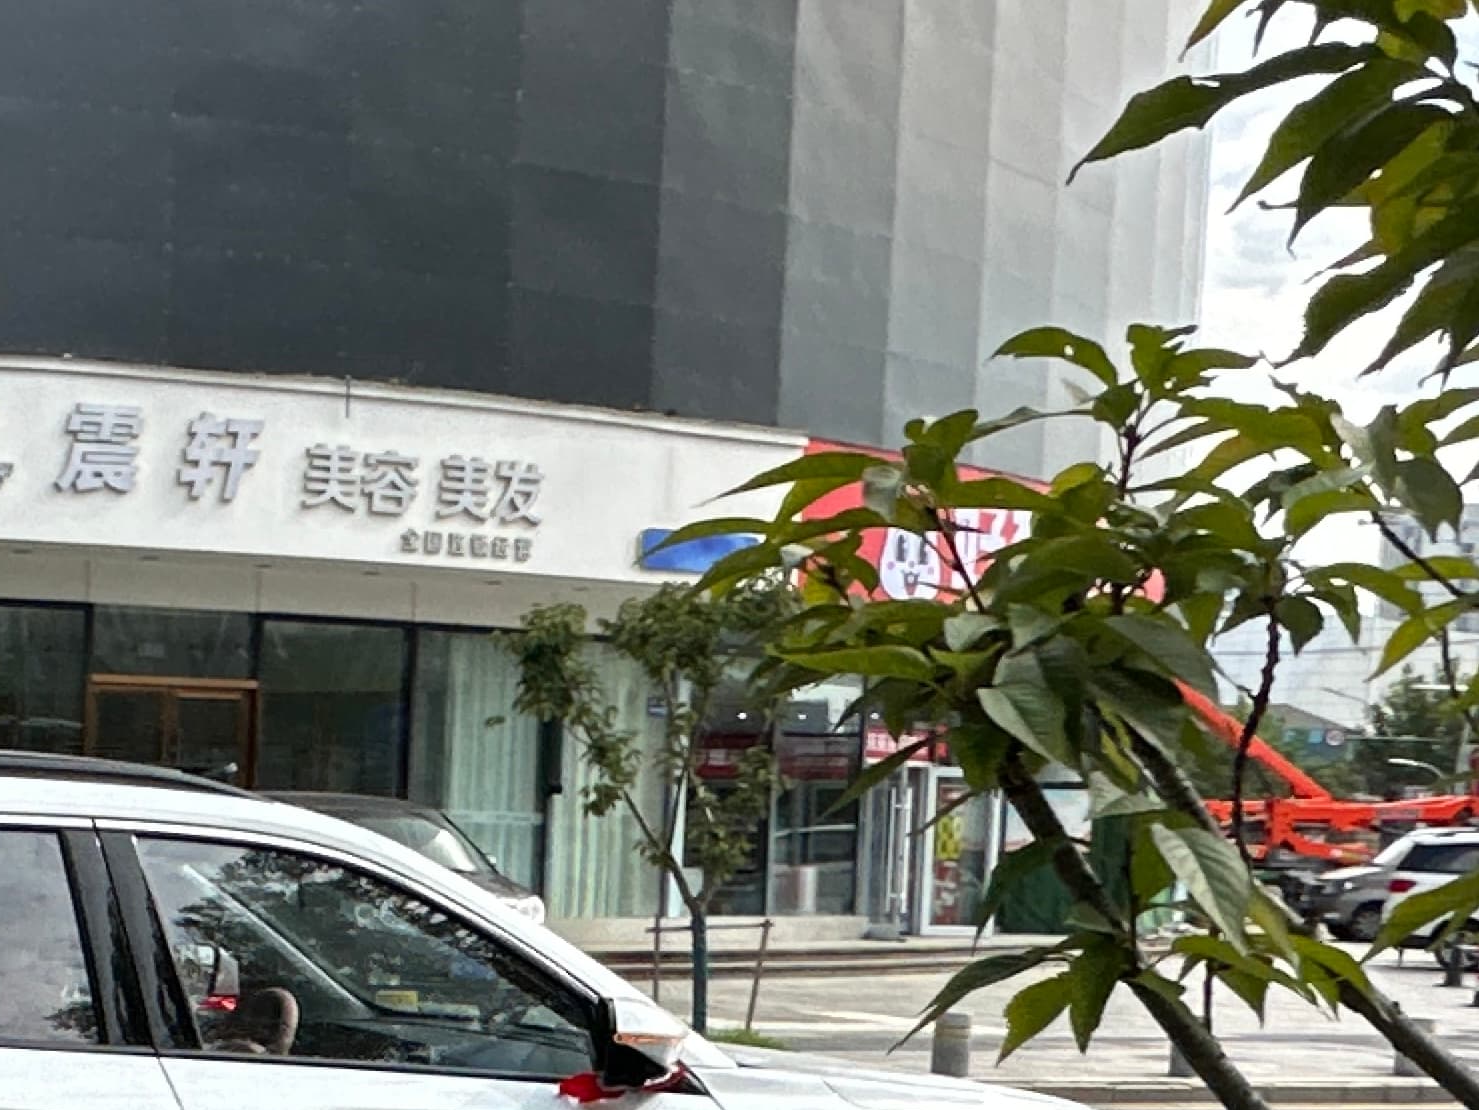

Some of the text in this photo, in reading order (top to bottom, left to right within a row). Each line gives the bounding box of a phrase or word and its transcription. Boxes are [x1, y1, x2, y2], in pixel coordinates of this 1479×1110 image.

[54, 402, 265, 503] 震轩
[299, 443, 544, 527] 美容美发
